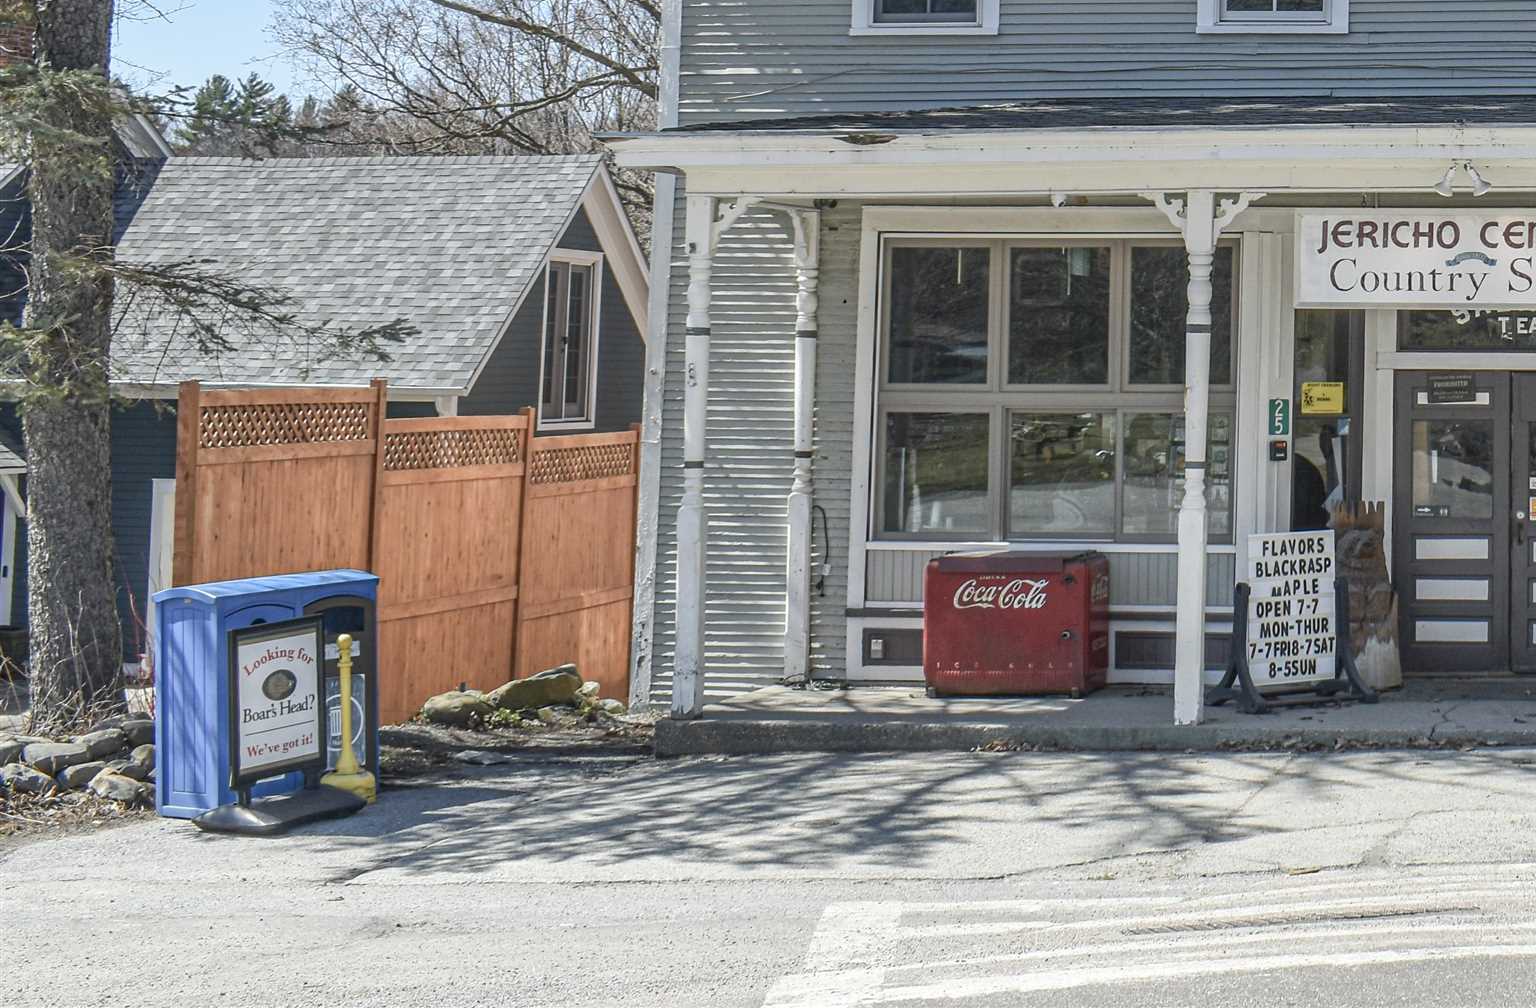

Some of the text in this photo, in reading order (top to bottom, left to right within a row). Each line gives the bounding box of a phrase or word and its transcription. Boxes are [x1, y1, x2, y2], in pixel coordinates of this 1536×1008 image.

[1317, 219, 1461, 254] JERICHO
[1329, 257, 1488, 301] Country
[1274, 399, 1284, 434] 25
[1262, 537, 1325, 556] FLAVORS
[1255, 557, 1331, 578] BLACKRASP
[953, 578, 1049, 609] Coca-Cola
[1256, 598, 1319, 618] OPEN 7-7
[1259, 617, 1329, 639] MON-THUR
[243, 646, 314, 676] Looking for
[243, 694, 315, 723] Boar's Head?
[247, 733, 313, 758] We've got it!
